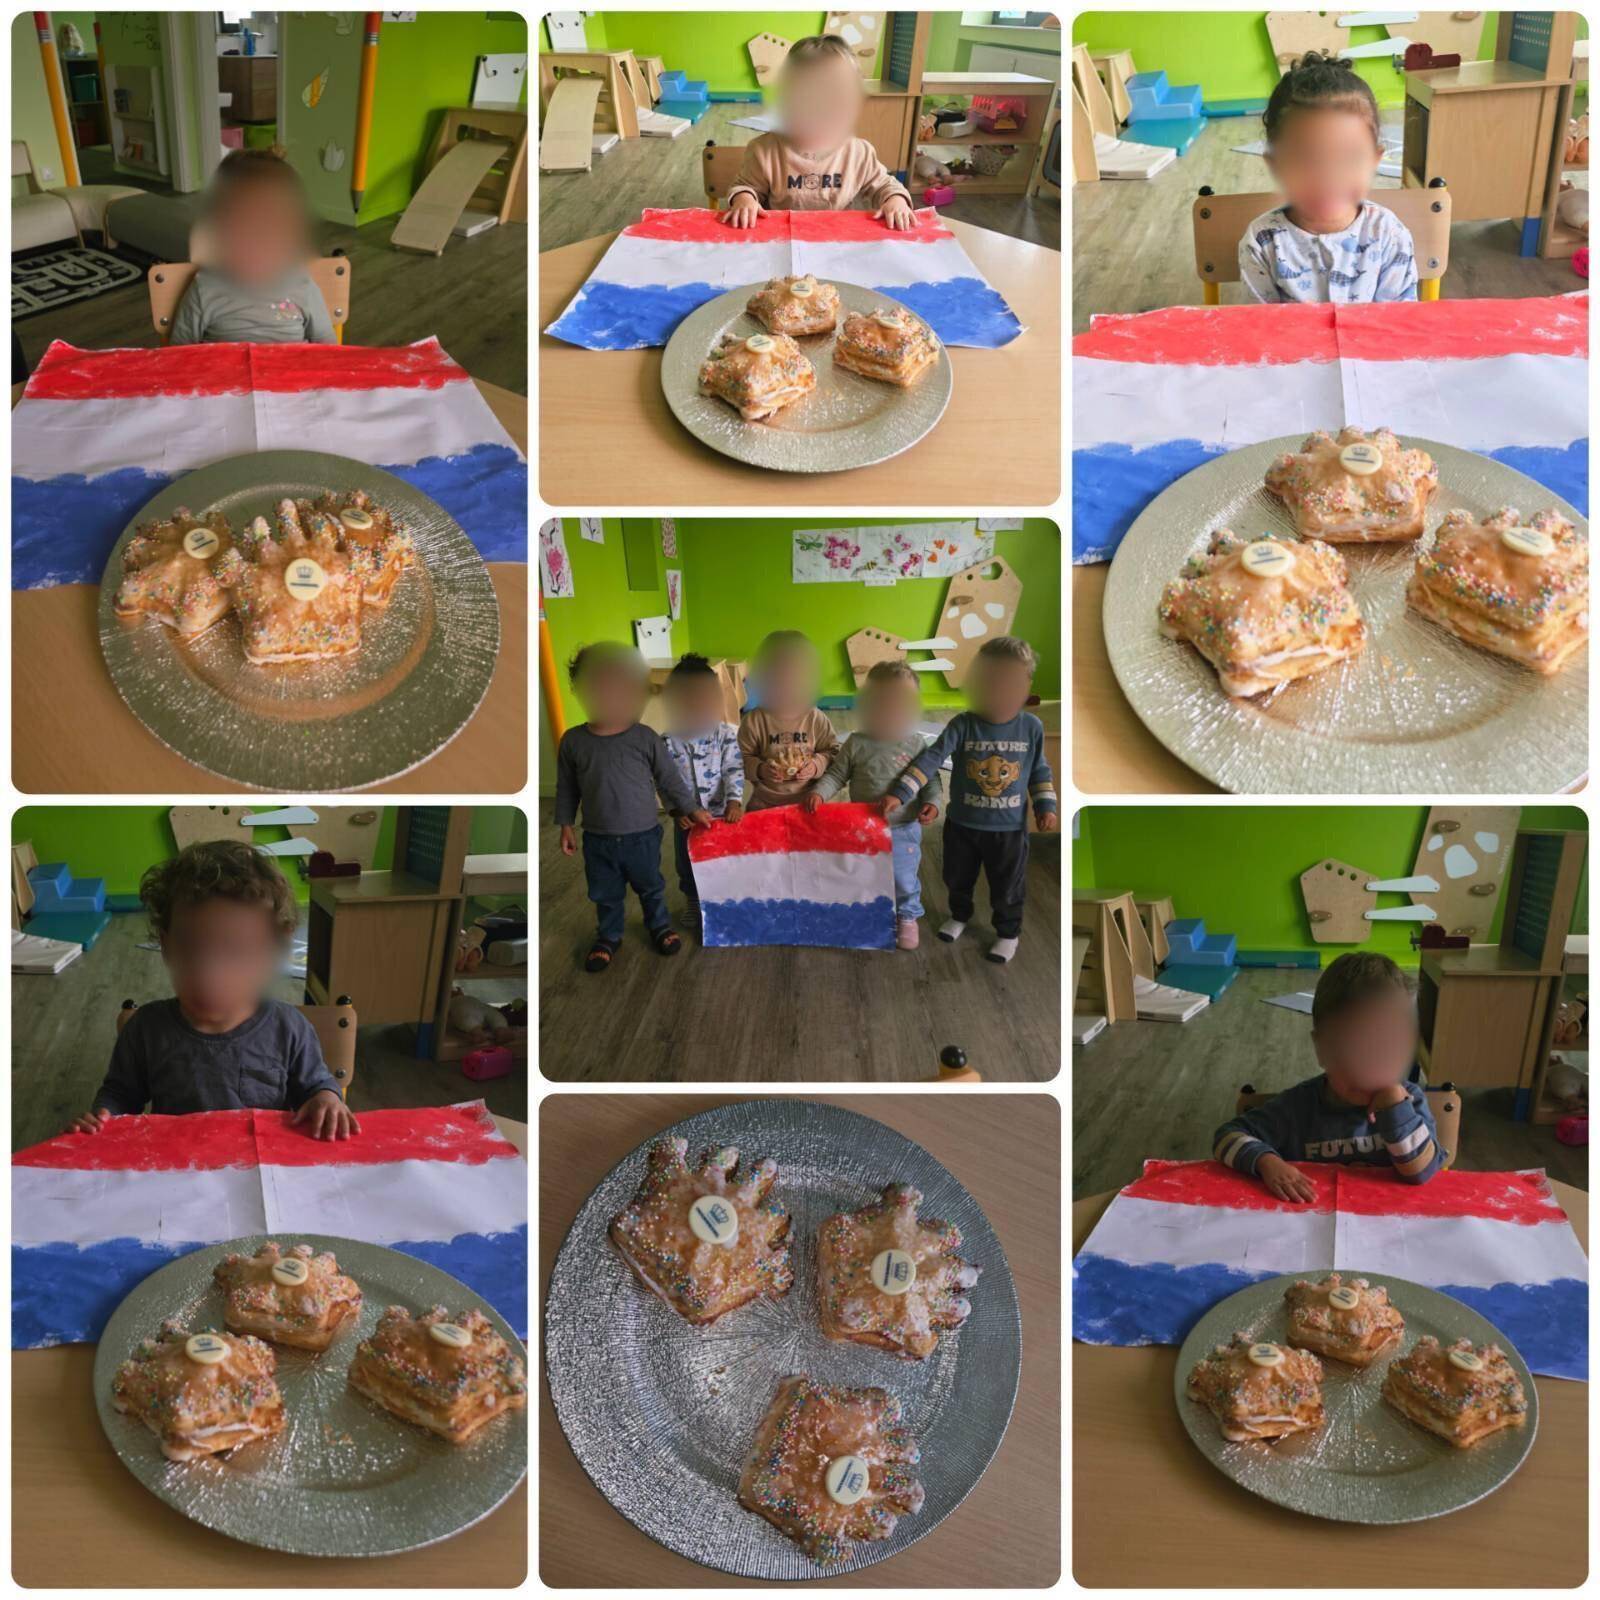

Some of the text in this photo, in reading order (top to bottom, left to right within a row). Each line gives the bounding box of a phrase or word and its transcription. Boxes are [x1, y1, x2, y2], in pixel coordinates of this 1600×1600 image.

[964, 740, 1029, 752] FUTURE
[964, 793, 1021, 809] KING
[1304, 1133, 1385, 1159] FUTUR
